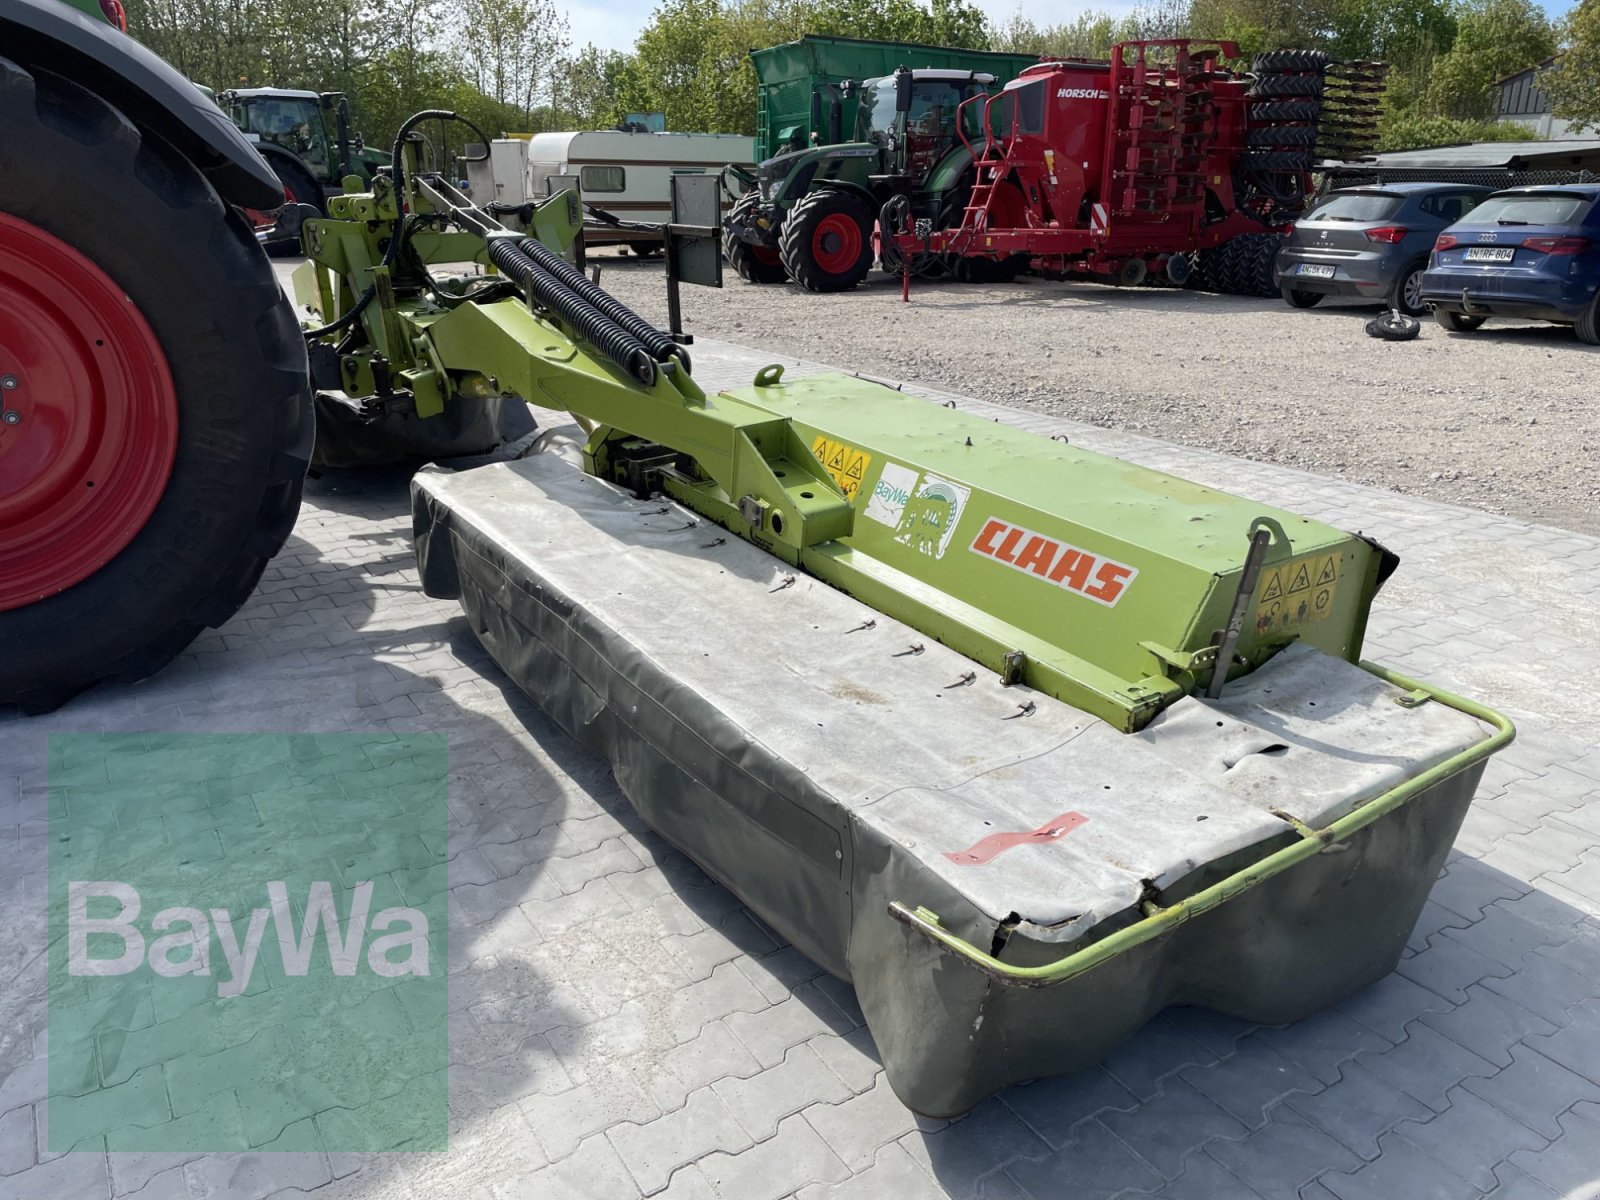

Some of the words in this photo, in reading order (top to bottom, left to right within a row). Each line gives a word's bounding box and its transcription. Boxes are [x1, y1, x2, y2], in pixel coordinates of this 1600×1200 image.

[1057, 88, 1098, 98] HORSCH
[1467, 249, 1479, 259] AN
[1482, 249, 1495, 259] RF
[1495, 249, 1513, 259] 804
[874, 480, 910, 506] BayWa
[973, 519, 1132, 604] CLAAS
